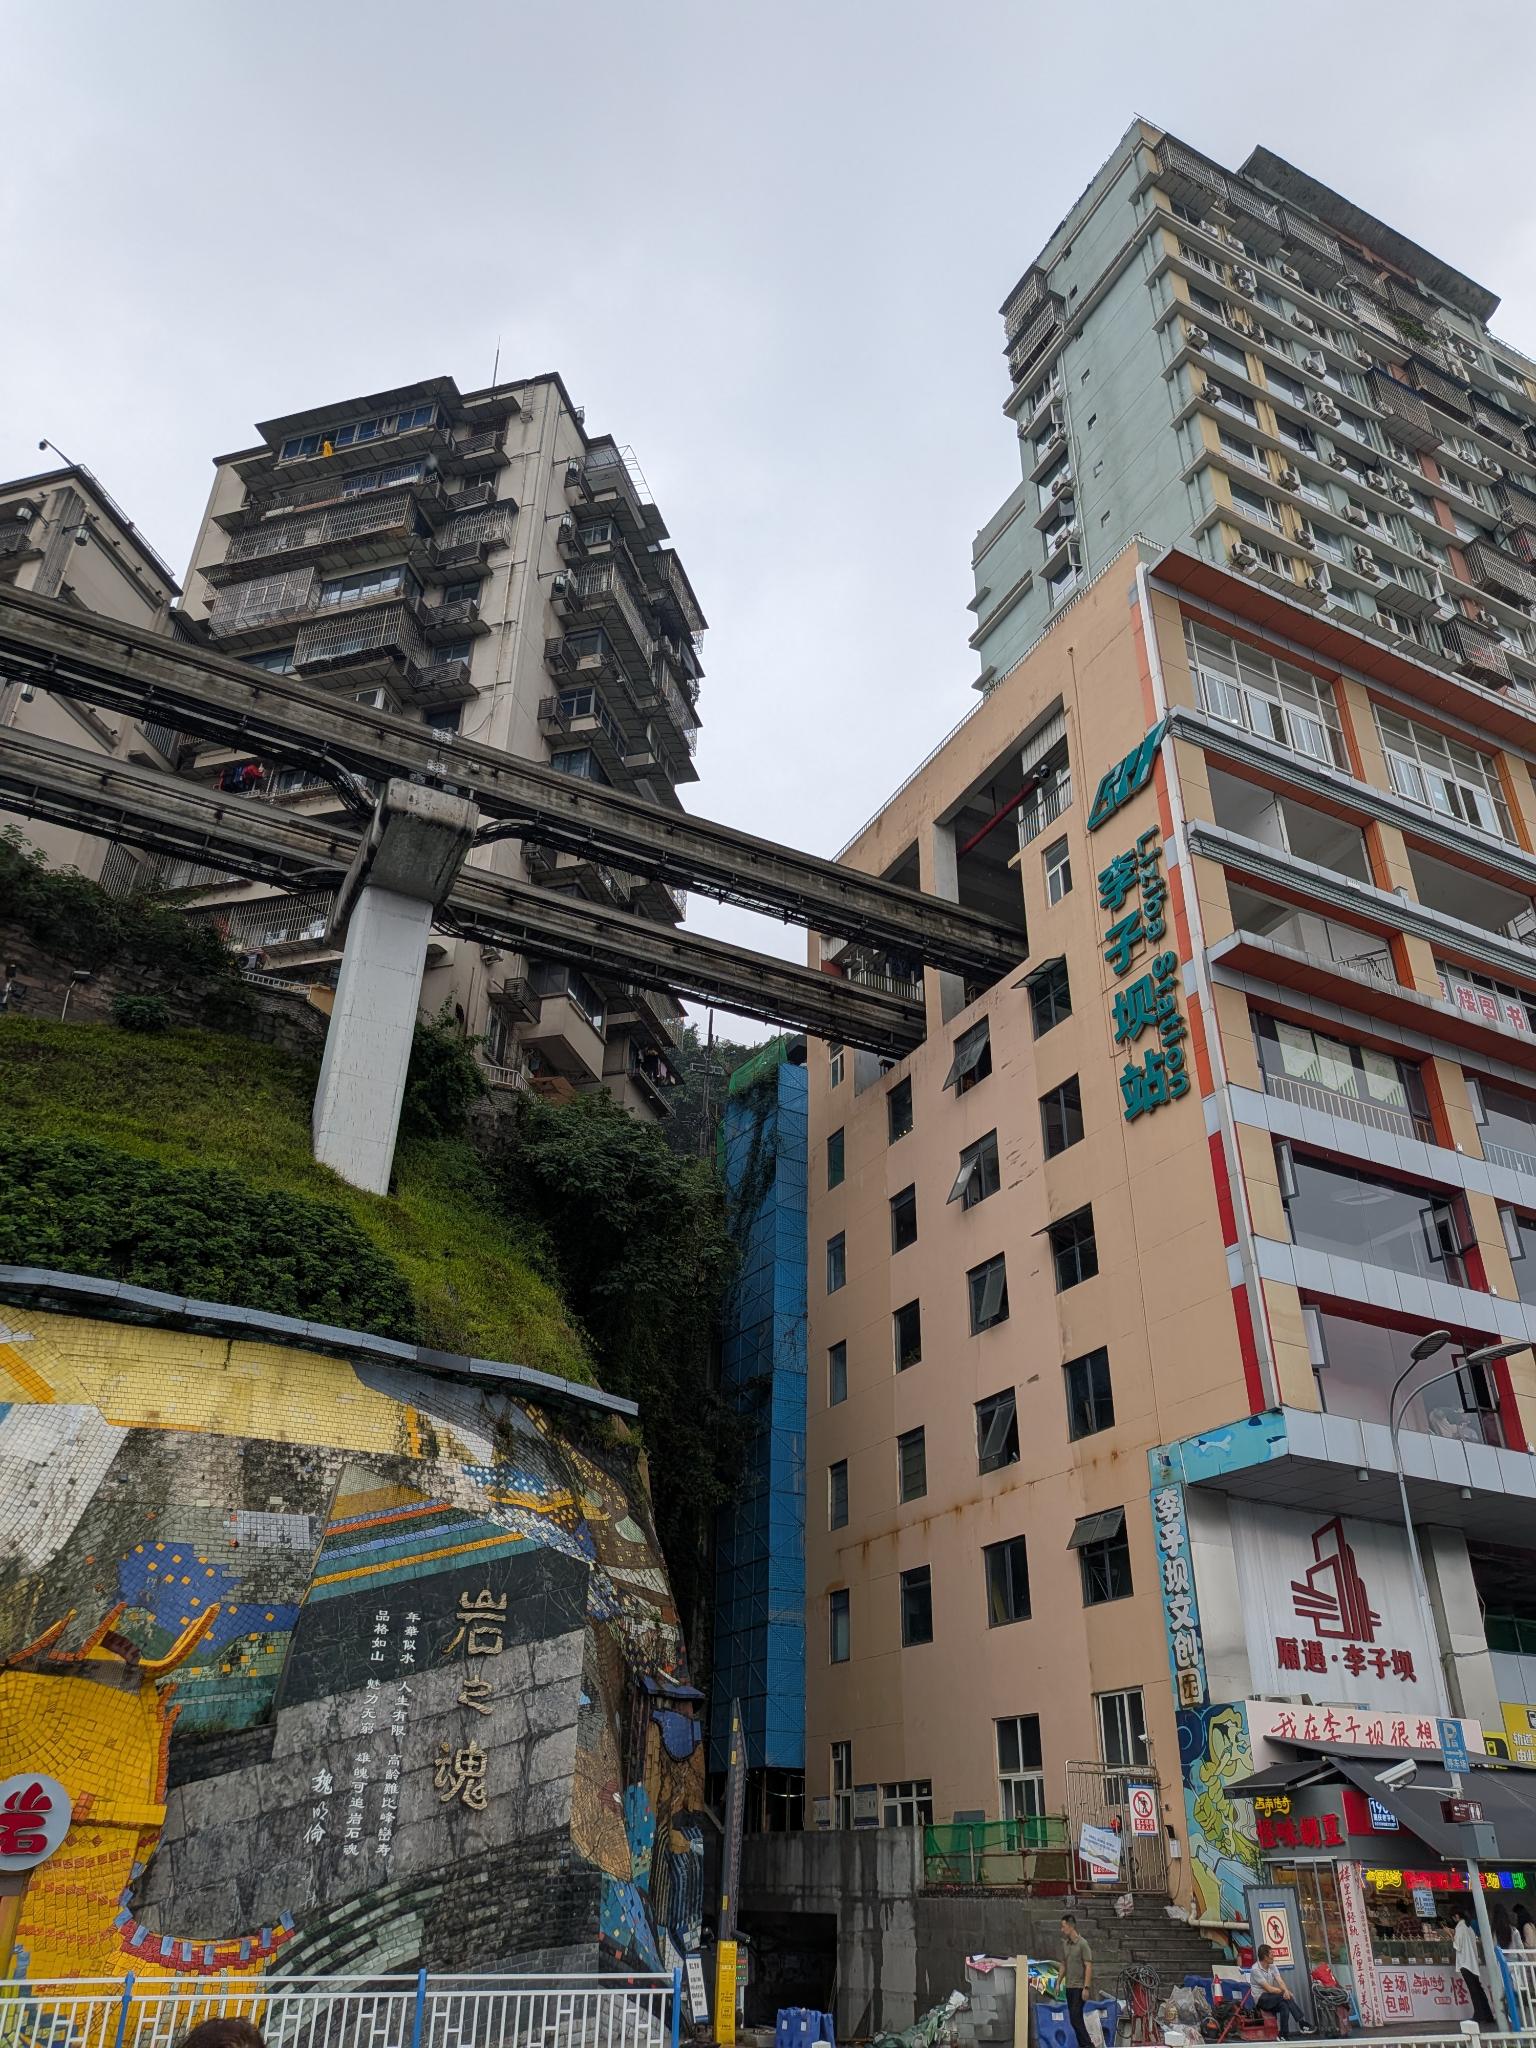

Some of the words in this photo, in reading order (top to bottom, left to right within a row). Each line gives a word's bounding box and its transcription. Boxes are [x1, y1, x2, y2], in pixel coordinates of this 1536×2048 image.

[1136, 824, 1165, 944] Liziba
[1152, 950, 1191, 1100] Station
[1098, 847, 1167, 1123] 李子坝站
[1154, 1488, 1203, 1706] 李子坝文创园
[433, 1589, 507, 1810] 岩之魂
[1271, 1708, 1437, 1749] 我在李子坝很想
[1443, 1722, 1458, 1748] P
[1512, 1731, 1536, 1746] 轨道
[1382, 1974, 1408, 1993] 全场
[1385, 1995, 1411, 2013] 包邮
